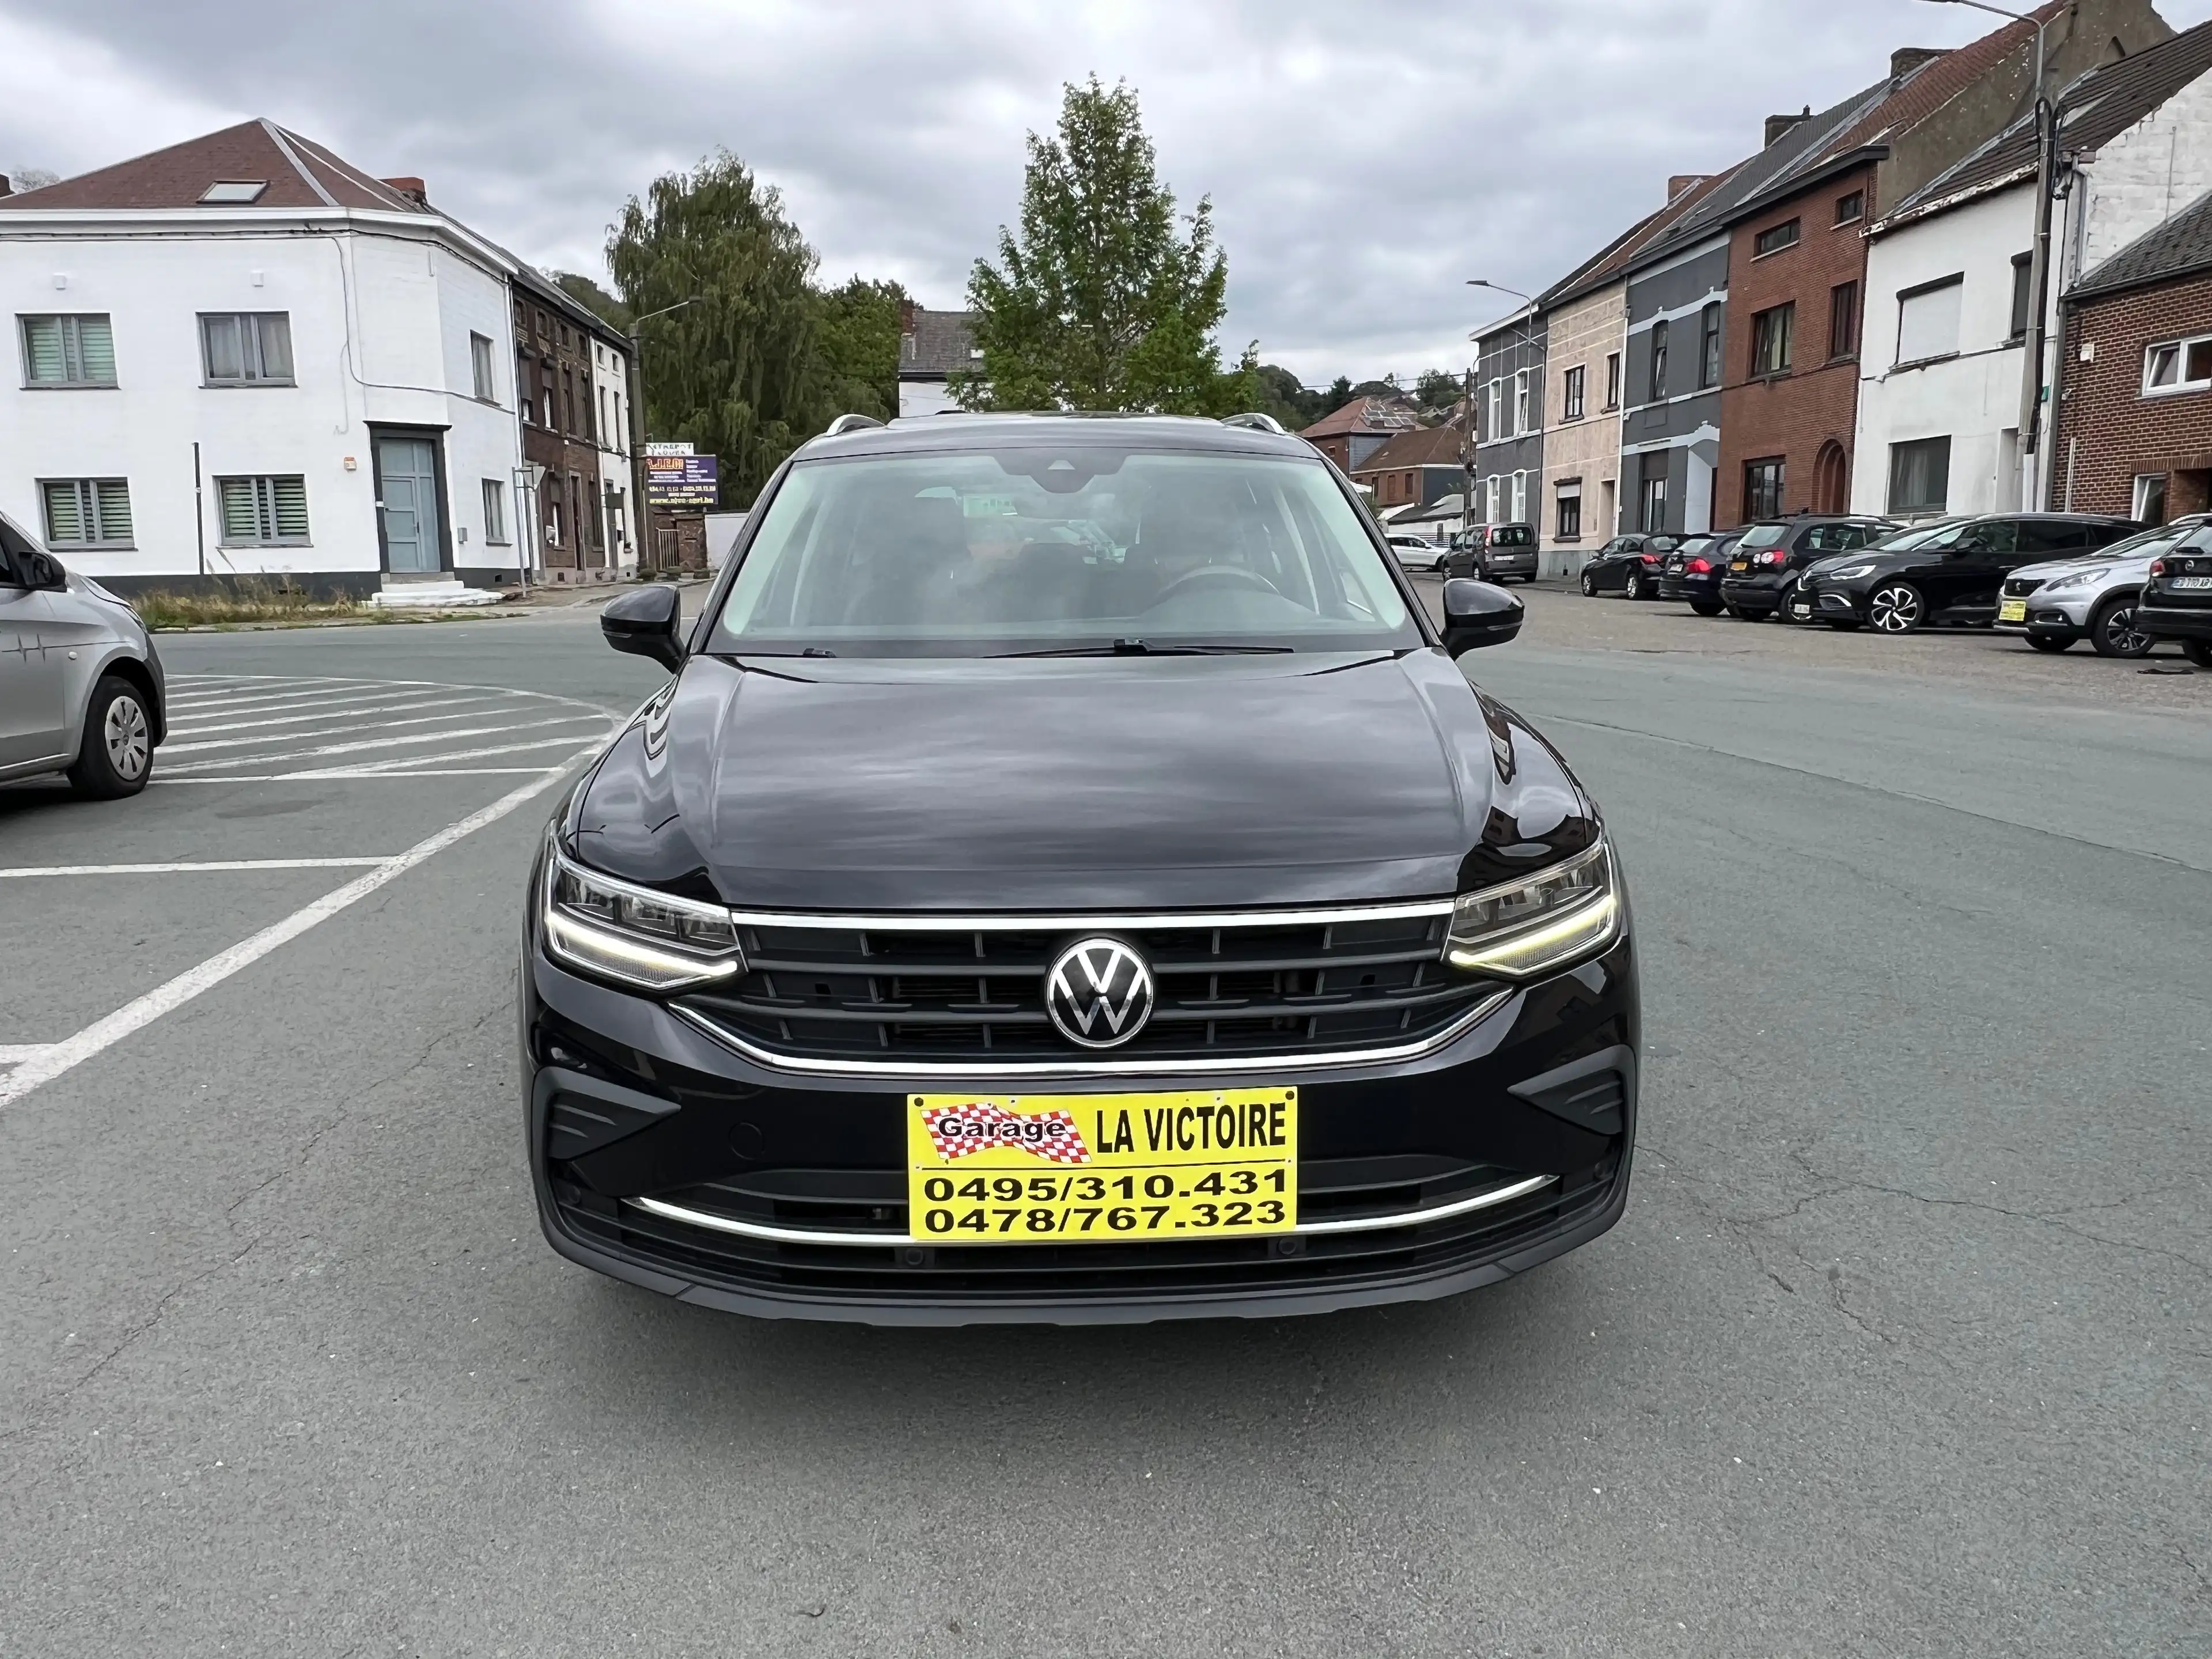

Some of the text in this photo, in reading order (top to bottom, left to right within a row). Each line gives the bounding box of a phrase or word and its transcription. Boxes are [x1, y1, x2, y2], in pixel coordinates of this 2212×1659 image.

[939, 1102, 1286, 1153] Garage LA VICTOIRE
[925, 1169, 1285, 1201] 0495/310.431
[925, 1200, 1285, 1232] 0478/767.323
